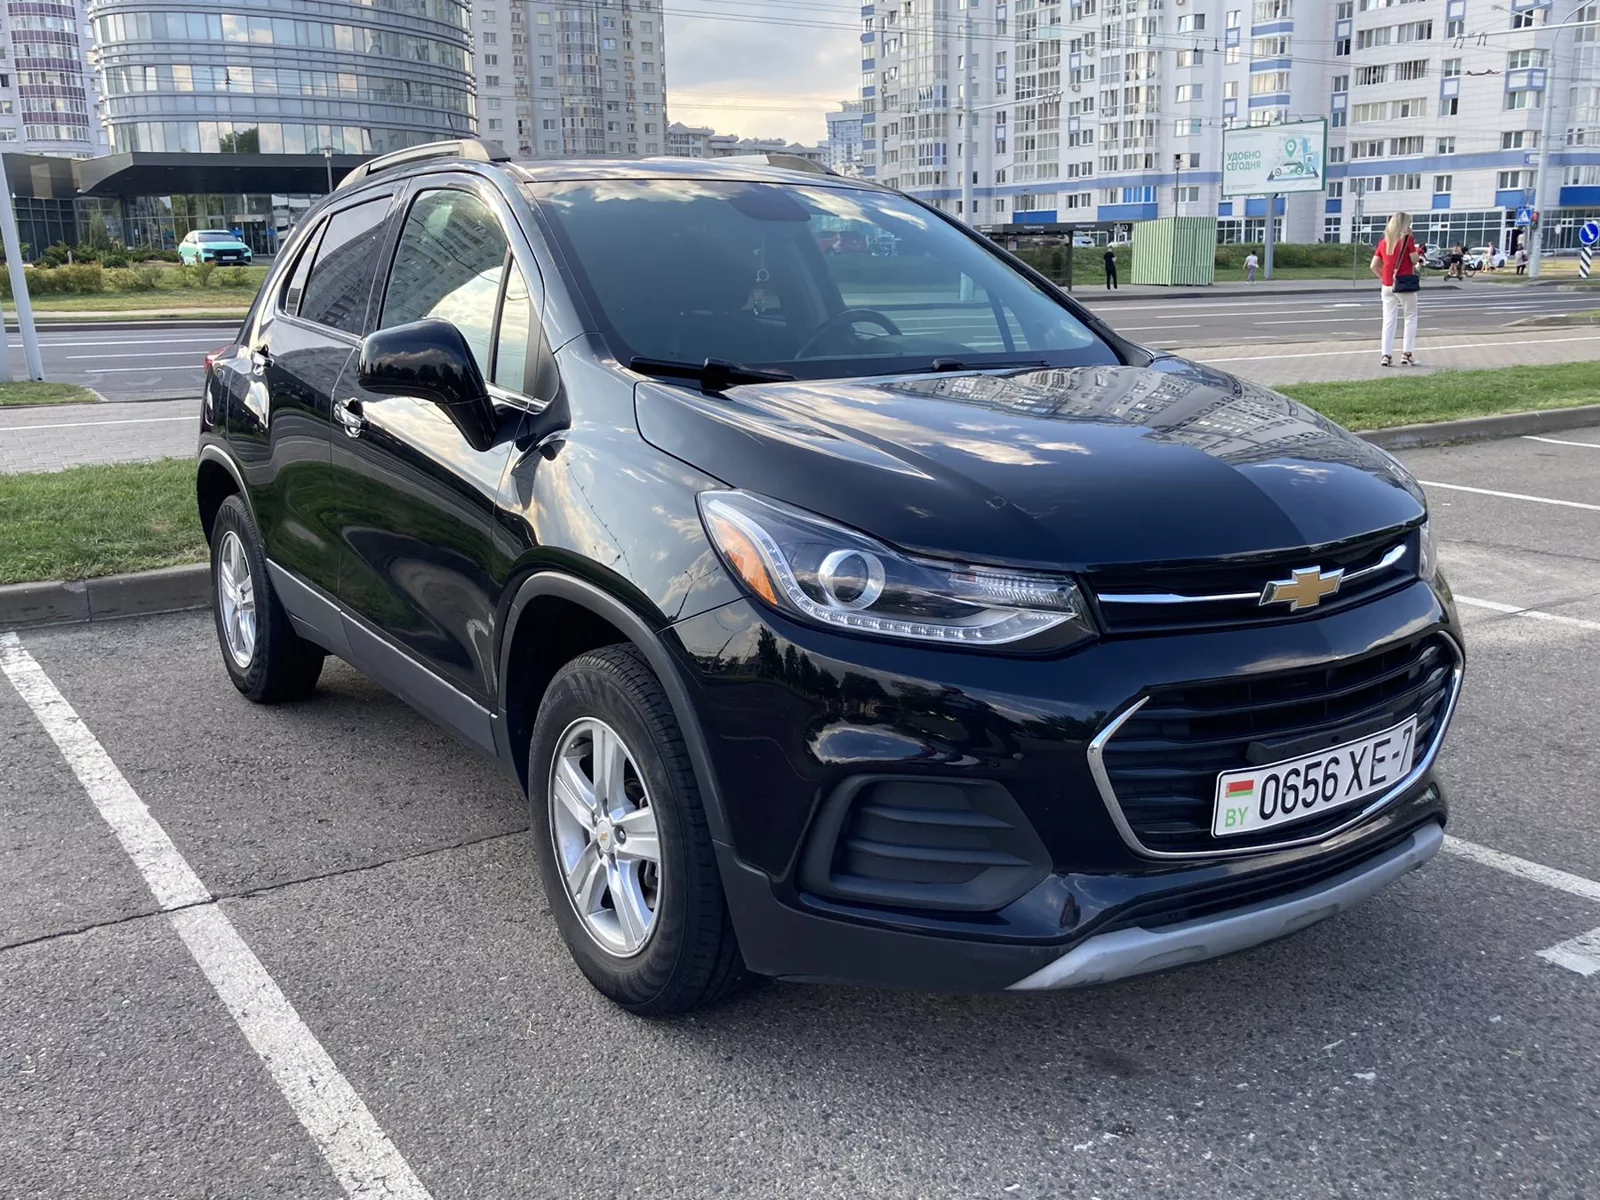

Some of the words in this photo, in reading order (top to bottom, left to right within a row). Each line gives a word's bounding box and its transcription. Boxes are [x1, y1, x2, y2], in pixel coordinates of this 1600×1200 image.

[1227, 150, 1261, 162] УДОБНО
[1226, 161, 1261, 171] СЕГОДНЯ
[1259, 757, 1340, 820] 0656
[1345, 725, 1413, 796] XE-7
[1225, 807, 1249, 827] BY
